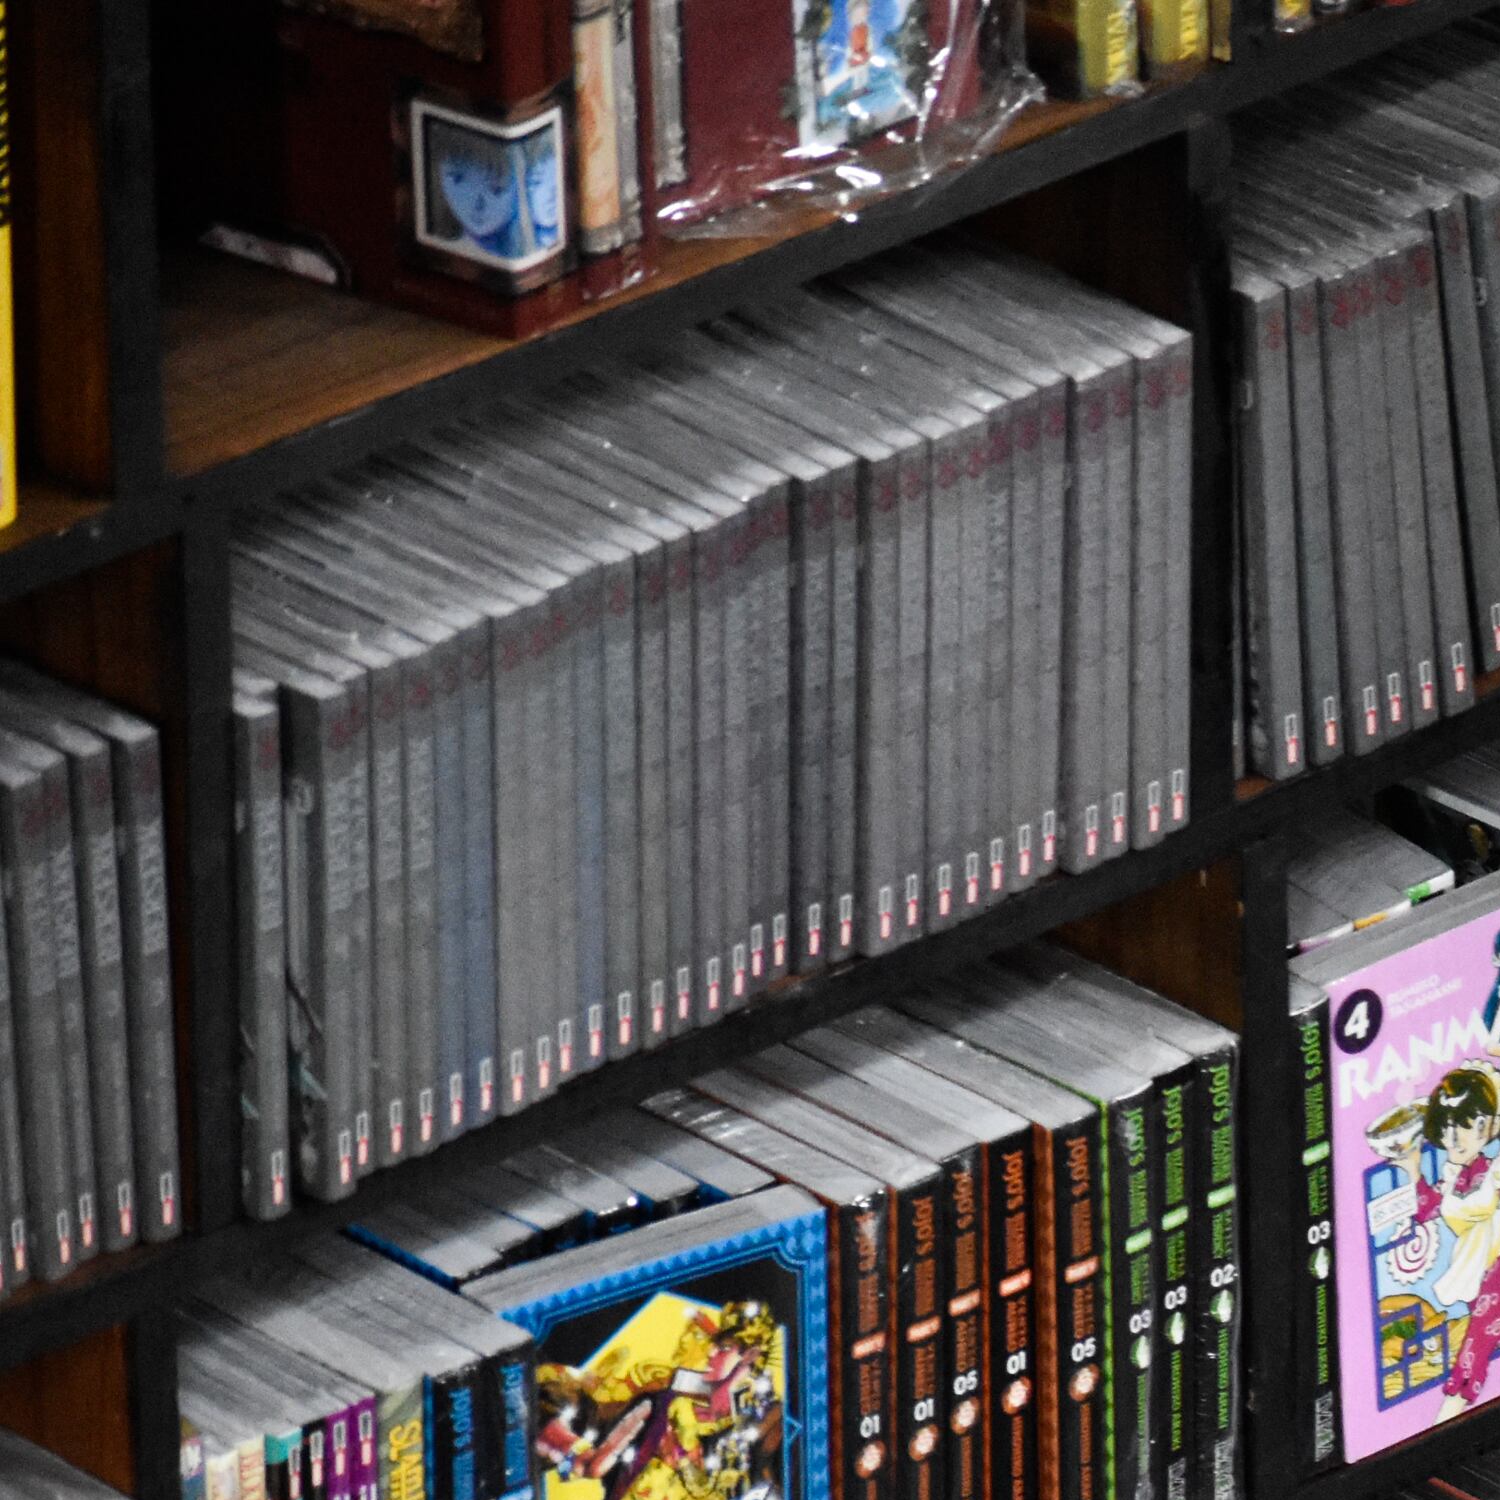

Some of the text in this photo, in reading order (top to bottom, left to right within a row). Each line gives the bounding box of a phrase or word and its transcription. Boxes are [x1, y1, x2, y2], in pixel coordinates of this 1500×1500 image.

[1343, 1002, 1371, 1040] 4
[1307, 1221, 1331, 1246] 03
[1210, 1264, 1234, 1287] 02
[1070, 1339, 1098, 1362] 05
[1006, 1352, 1028, 1374] 01
